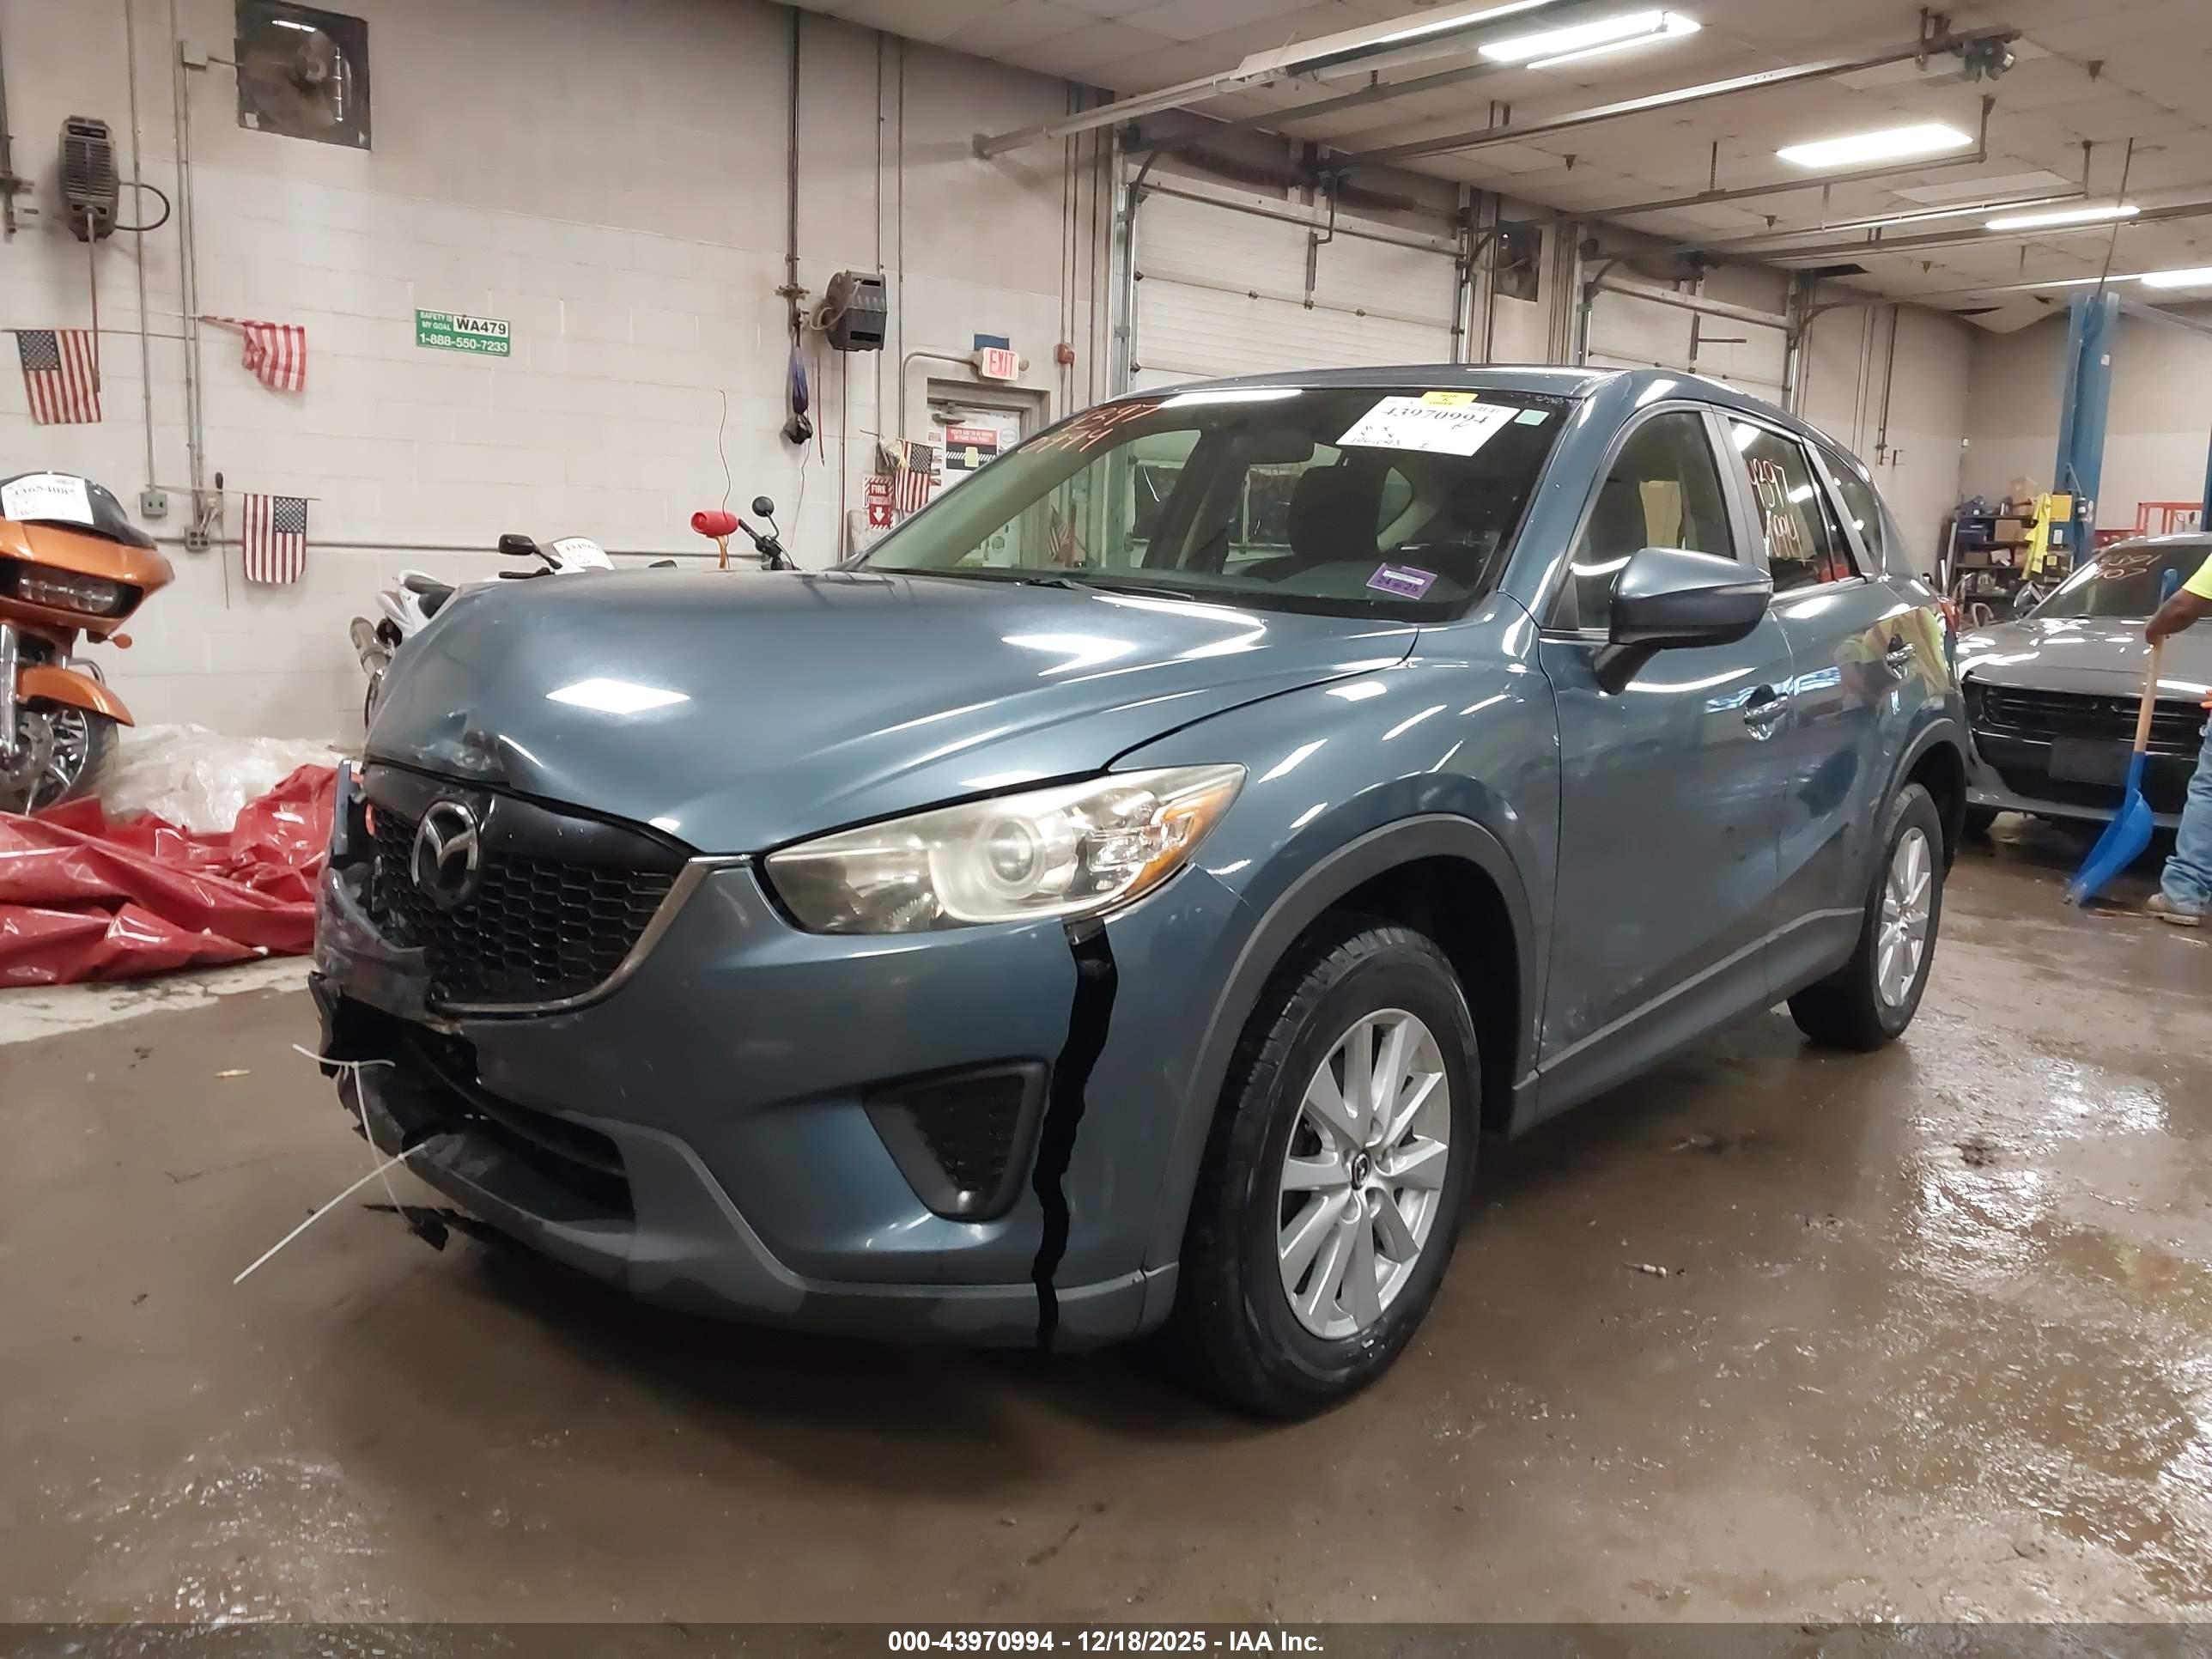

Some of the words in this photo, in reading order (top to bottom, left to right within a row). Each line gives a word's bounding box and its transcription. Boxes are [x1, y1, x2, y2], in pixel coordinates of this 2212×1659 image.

[420, 311, 446, 321] SAFETY
[432, 322, 452, 331] GOAL
[456, 317, 507, 335] WA479
[419, 332, 508, 353] 1-888-550-7233
[989, 349, 1015, 378] EXIT
[1382, 407, 1489, 425] 43970994
[871, 483, 886, 495] FIRE
